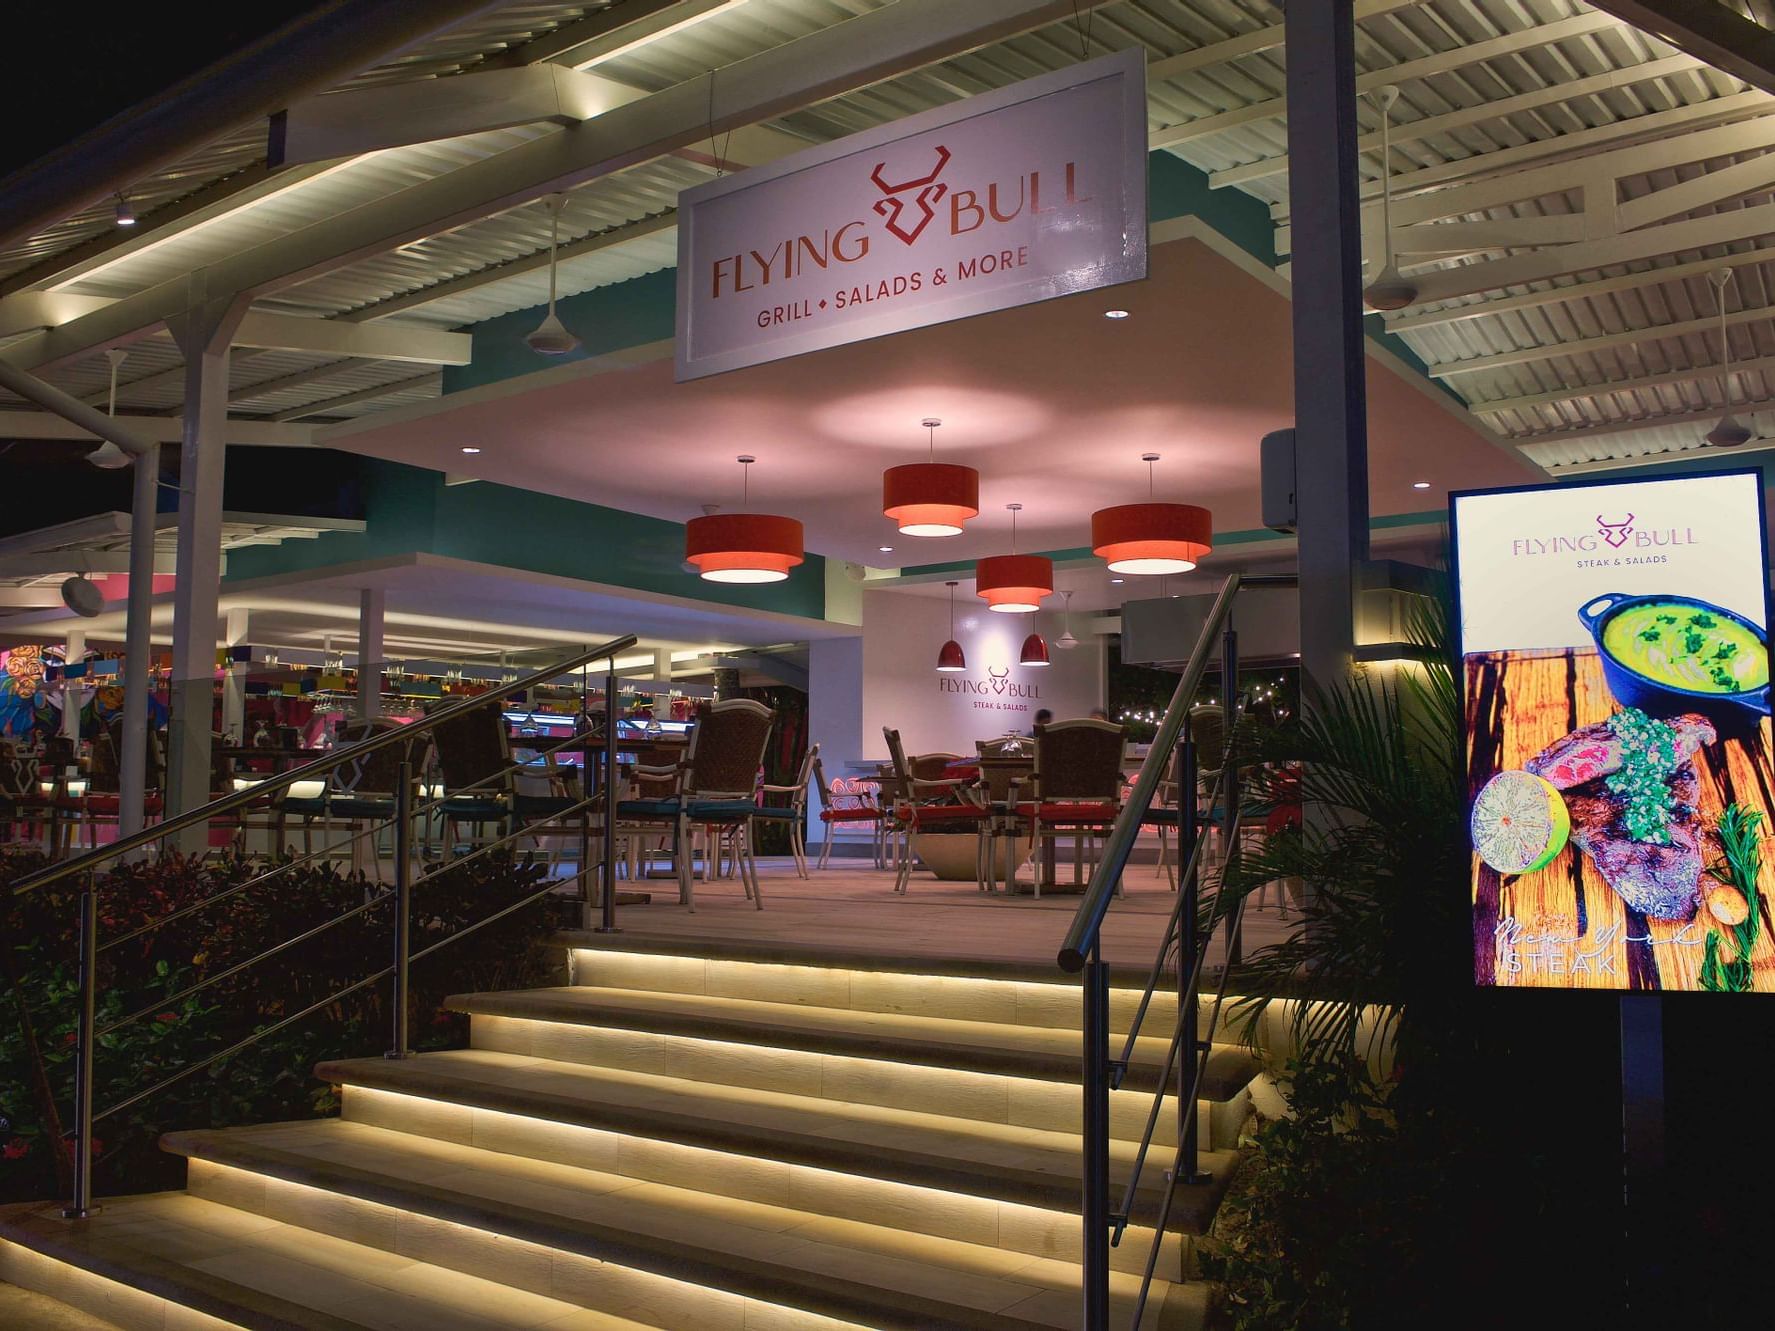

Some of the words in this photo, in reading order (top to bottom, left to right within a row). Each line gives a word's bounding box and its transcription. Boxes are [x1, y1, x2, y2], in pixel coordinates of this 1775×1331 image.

[713, 221, 870, 299] FLYING
[950, 162, 1089, 235] BULL
[757, 299, 812, 329] GRILL
[835, 272, 922, 309] SALADS
[932, 267, 948, 286] &
[958, 245, 1029, 280] MORE
[1513, 535, 1597, 556] FLYING
[1635, 528, 1699, 548] BULL
[1577, 558, 1610, 568] STEAK
[1614, 557, 1621, 566] &
[1625, 555, 1668, 565] SALADS
[940, 677, 988, 695] FLYING
[1009, 682, 1043, 698] BULL
[973, 701, 994, 709] STEAK
[1003, 703, 1028, 711] SALADS
[1505, 951, 1617, 975] STEAK
